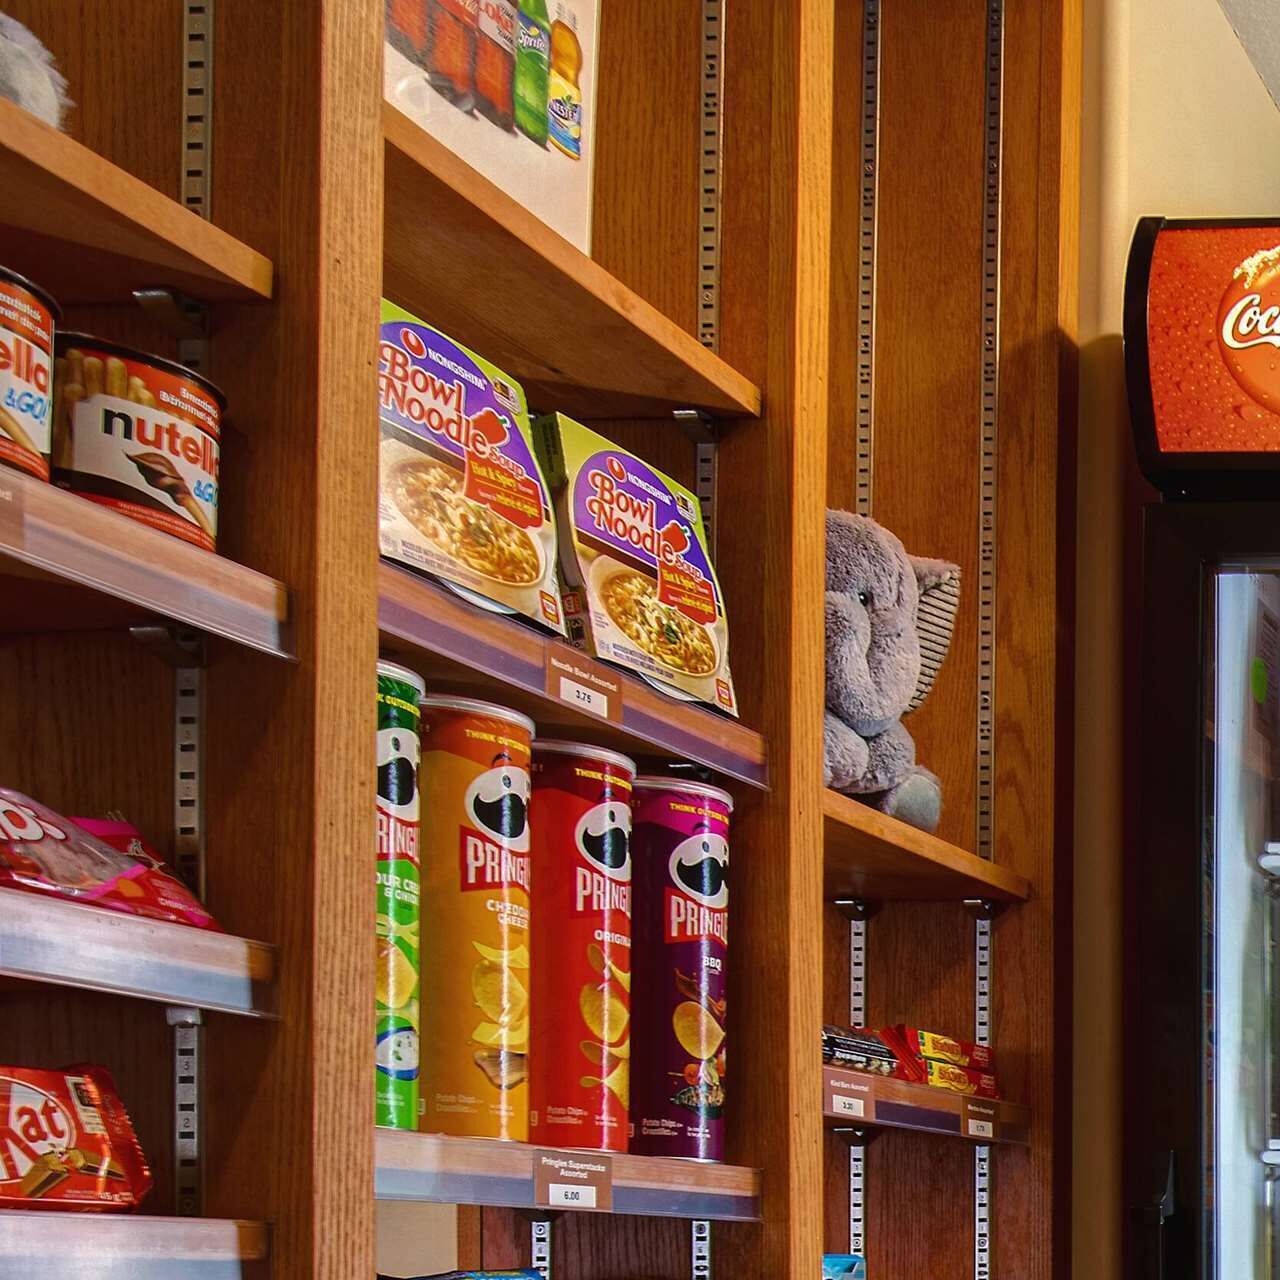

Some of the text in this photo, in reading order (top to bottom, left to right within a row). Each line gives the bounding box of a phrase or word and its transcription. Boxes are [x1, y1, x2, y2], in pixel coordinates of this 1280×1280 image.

[379, 340, 466, 409] Bowl
[427, 347, 487, 392] NONGSHIM
[379, 374, 488, 457] Noodle
[588, 468, 656, 529] Bowl
[586, 495, 674, 564] Noodle
[465, 729, 496, 745] THINK
[575, 767, 606, 783] THINK
[703, 957, 722, 972] BBQ
[541, 1155, 567, 1170] Pringles
